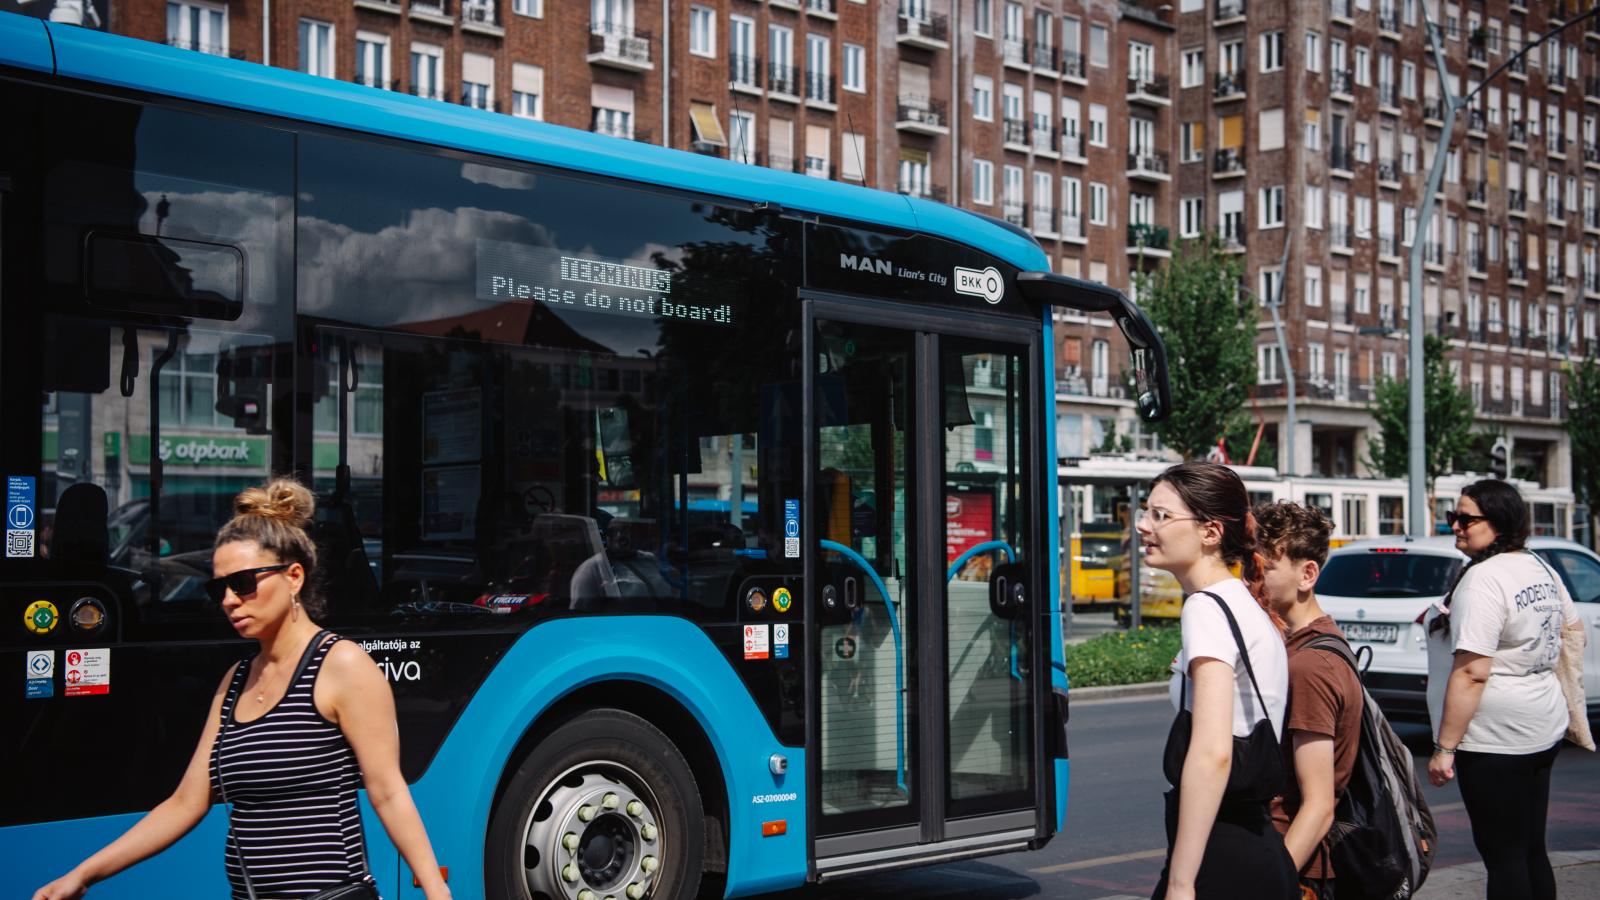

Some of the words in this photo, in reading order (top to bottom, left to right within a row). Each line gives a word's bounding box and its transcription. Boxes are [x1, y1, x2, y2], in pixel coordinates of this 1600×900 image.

[561, 256, 671, 293] TERMINUS
[840, 253, 892, 275] MAN
[898, 267, 925, 281] Lion's
[928, 272, 947, 286] City
[961, 275, 982, 288] BKK
[493, 276, 576, 304] Please
[584, 288, 611, 309] do
[619, 296, 655, 314] not
[661, 298, 731, 323] board!
[175, 439, 249, 464] otpbank
[1515, 584, 1546, 613] RODEO
[410, 641, 421, 649] az
